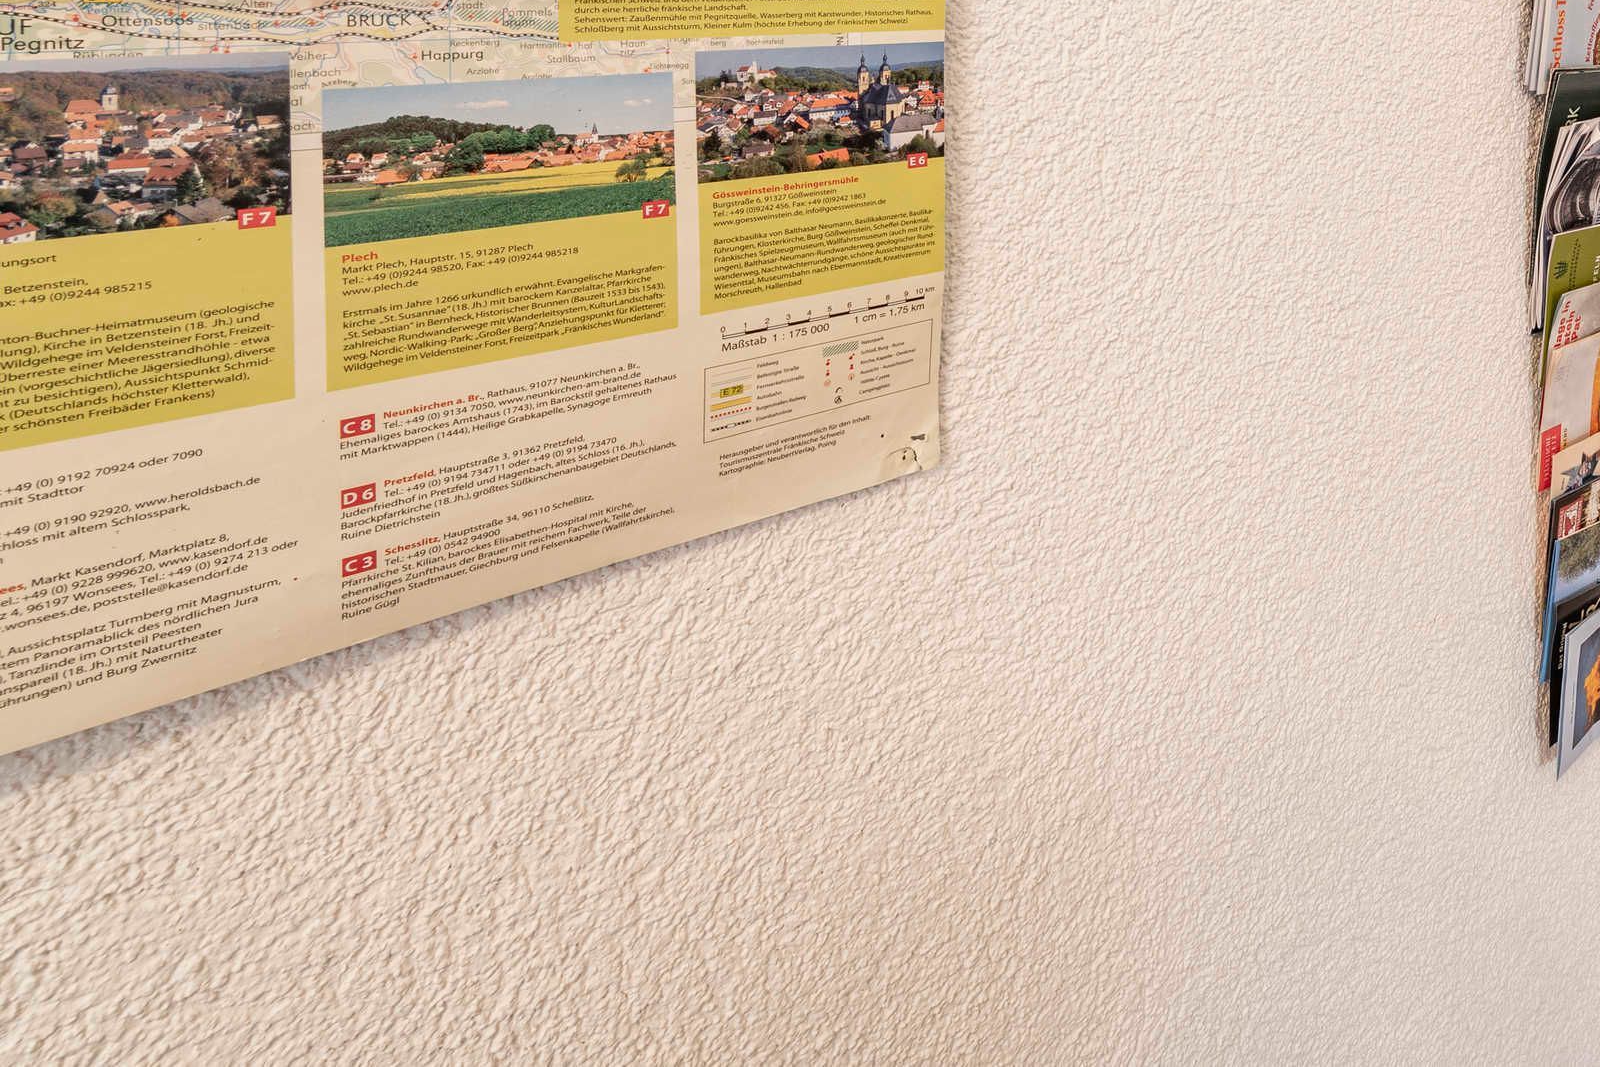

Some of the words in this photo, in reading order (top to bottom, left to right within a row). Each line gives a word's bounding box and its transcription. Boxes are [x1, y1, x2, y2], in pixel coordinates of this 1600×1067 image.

[346, 11, 412, 27] BRUCK
[420, 47, 484, 63] Happurg
[713, 175, 859, 199] Gössweinstein-Behringersmühle
[342, 250, 378, 263] Plech
[343, 279, 418, 296] www.plech.de
